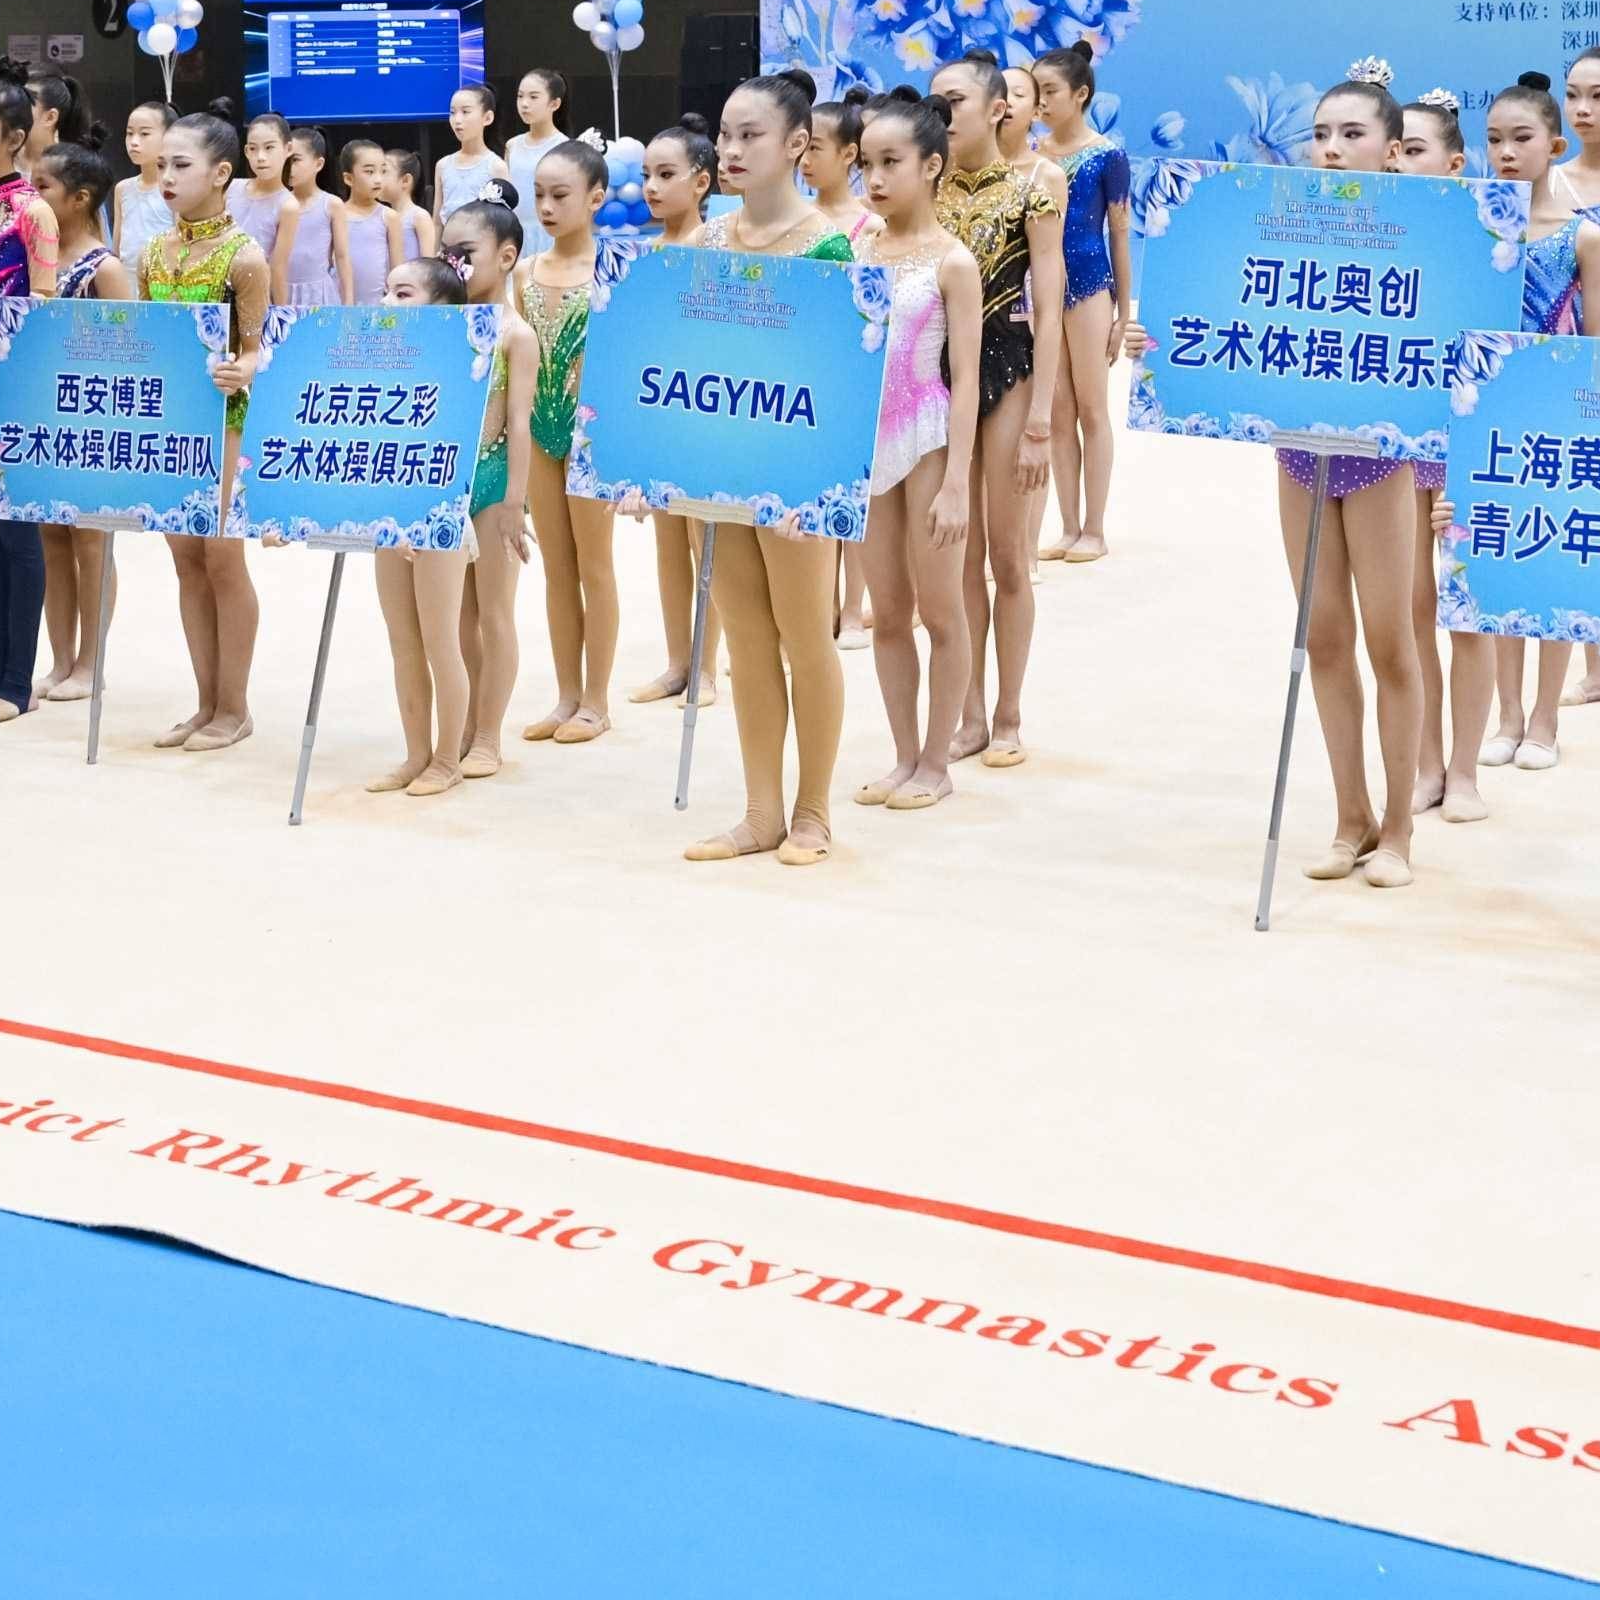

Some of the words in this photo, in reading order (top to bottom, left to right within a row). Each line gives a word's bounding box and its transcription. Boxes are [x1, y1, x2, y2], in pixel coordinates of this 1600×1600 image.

[1240, 255, 1423, 320] 河北奥创
[55, 373, 165, 420] 西安博望
[295, 382, 441, 430] 北京京之彩
[637, 365, 818, 431] SAGYMA
[256, 438, 461, 489] 艺术体操俱乐部
[128, 1126, 619, 1254] Rhythmic
[650, 1236, 1341, 1410] Gymnastics
